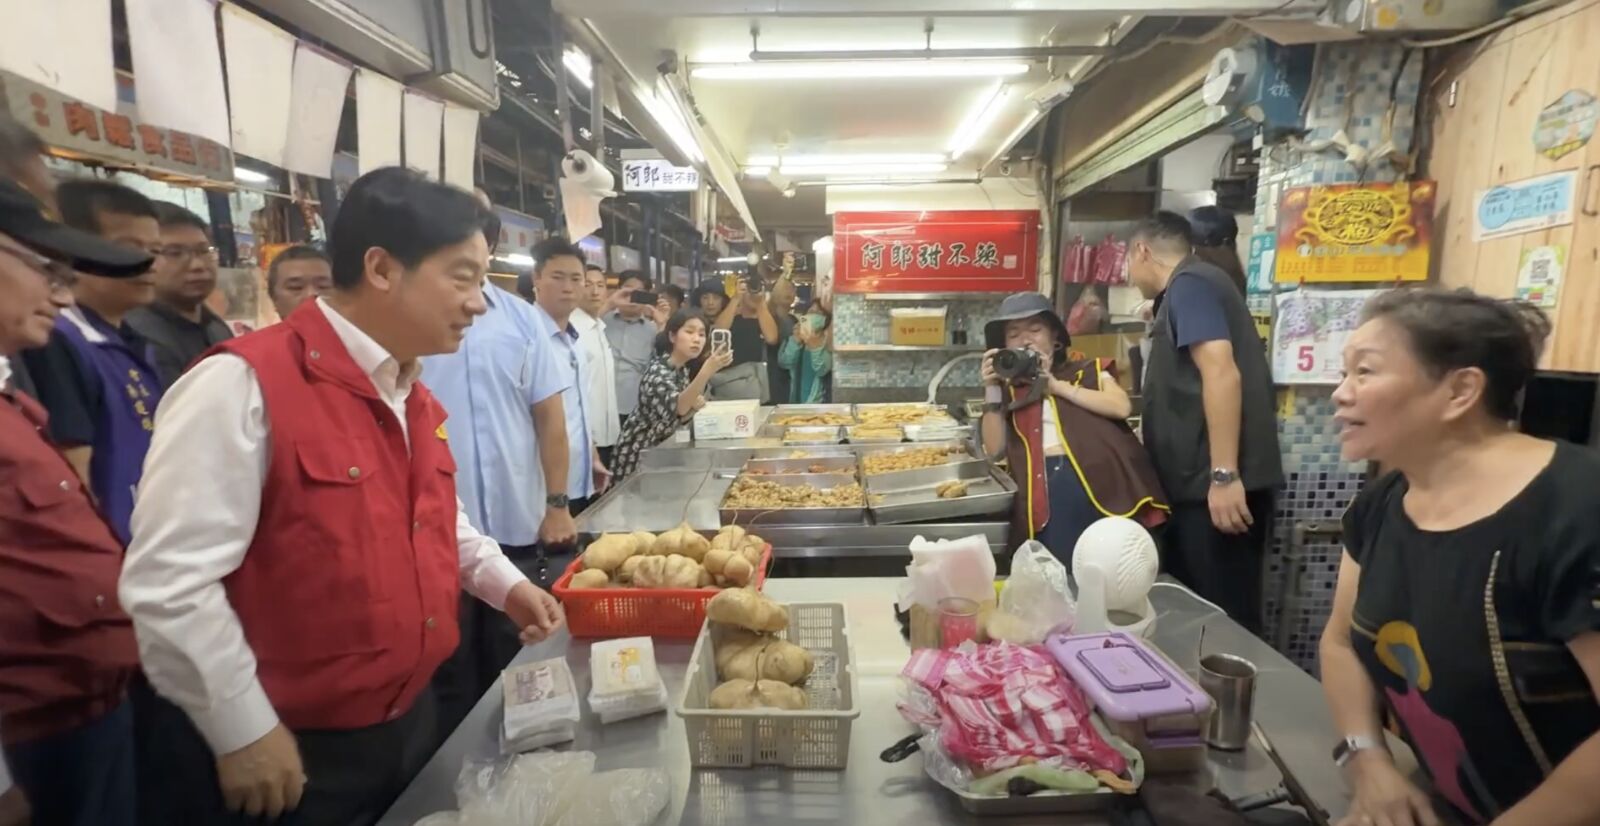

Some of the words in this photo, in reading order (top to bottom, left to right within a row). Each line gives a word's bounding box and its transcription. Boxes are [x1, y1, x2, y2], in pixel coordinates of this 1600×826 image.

[862, 241, 999, 271] 阿郎甜不辣
[1297, 345, 1314, 371] 5
